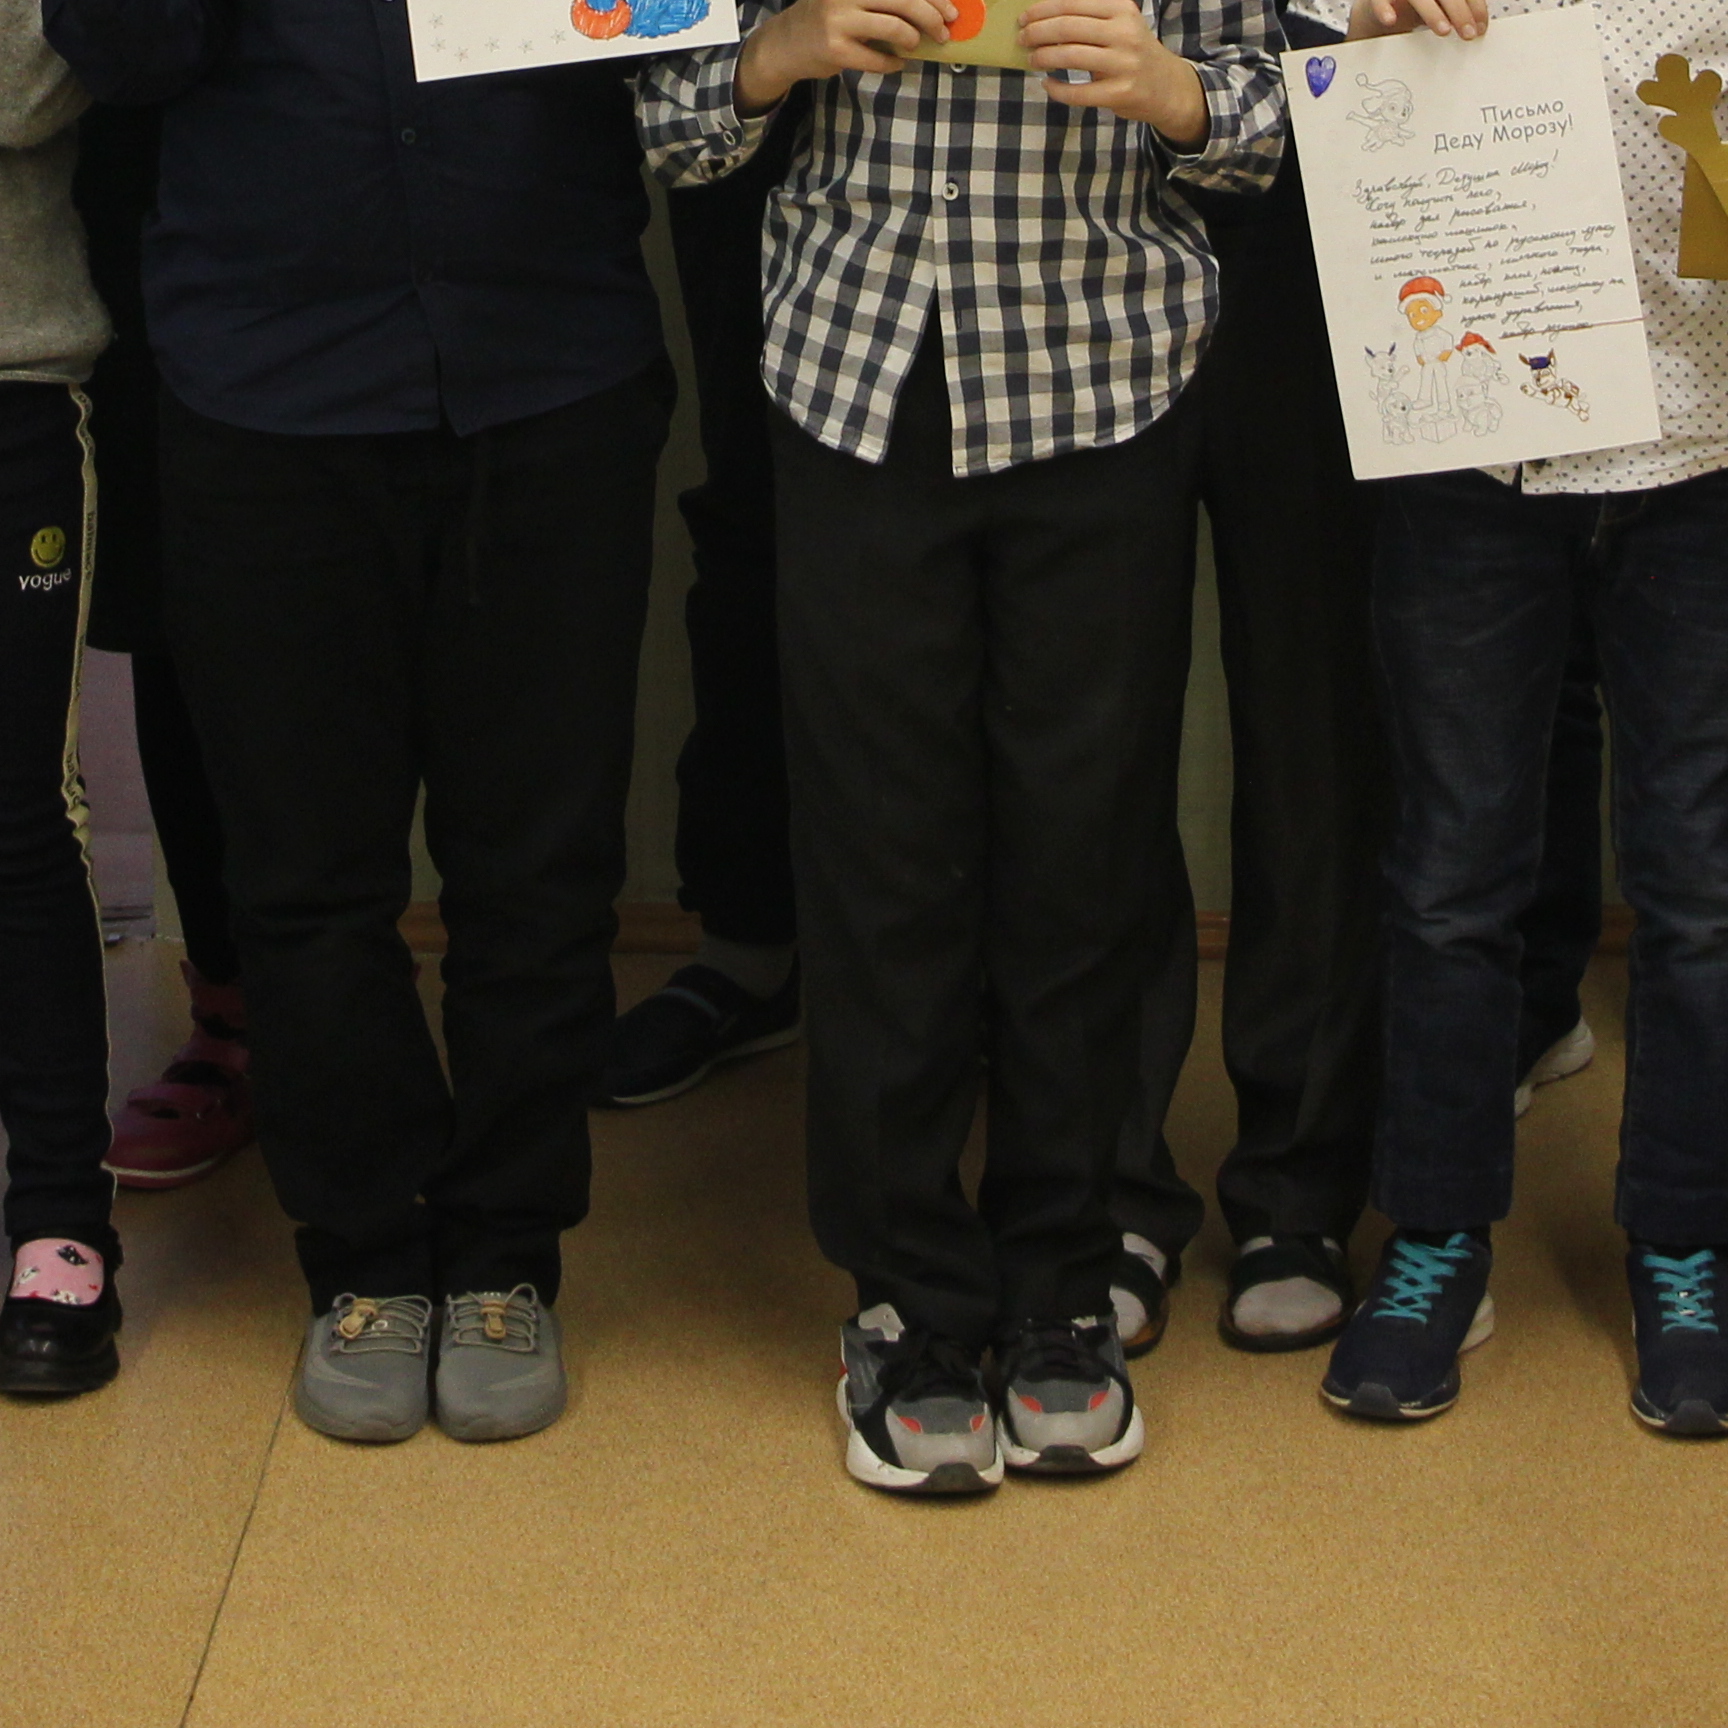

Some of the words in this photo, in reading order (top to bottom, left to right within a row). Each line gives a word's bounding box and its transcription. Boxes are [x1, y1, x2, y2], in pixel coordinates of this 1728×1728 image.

[1480, 98, 1565, 125] Письмо
[1433, 129, 1485, 155] Деду
[1491, 112, 1575, 145] Морозу!
[18, 568, 72, 592] vogue
